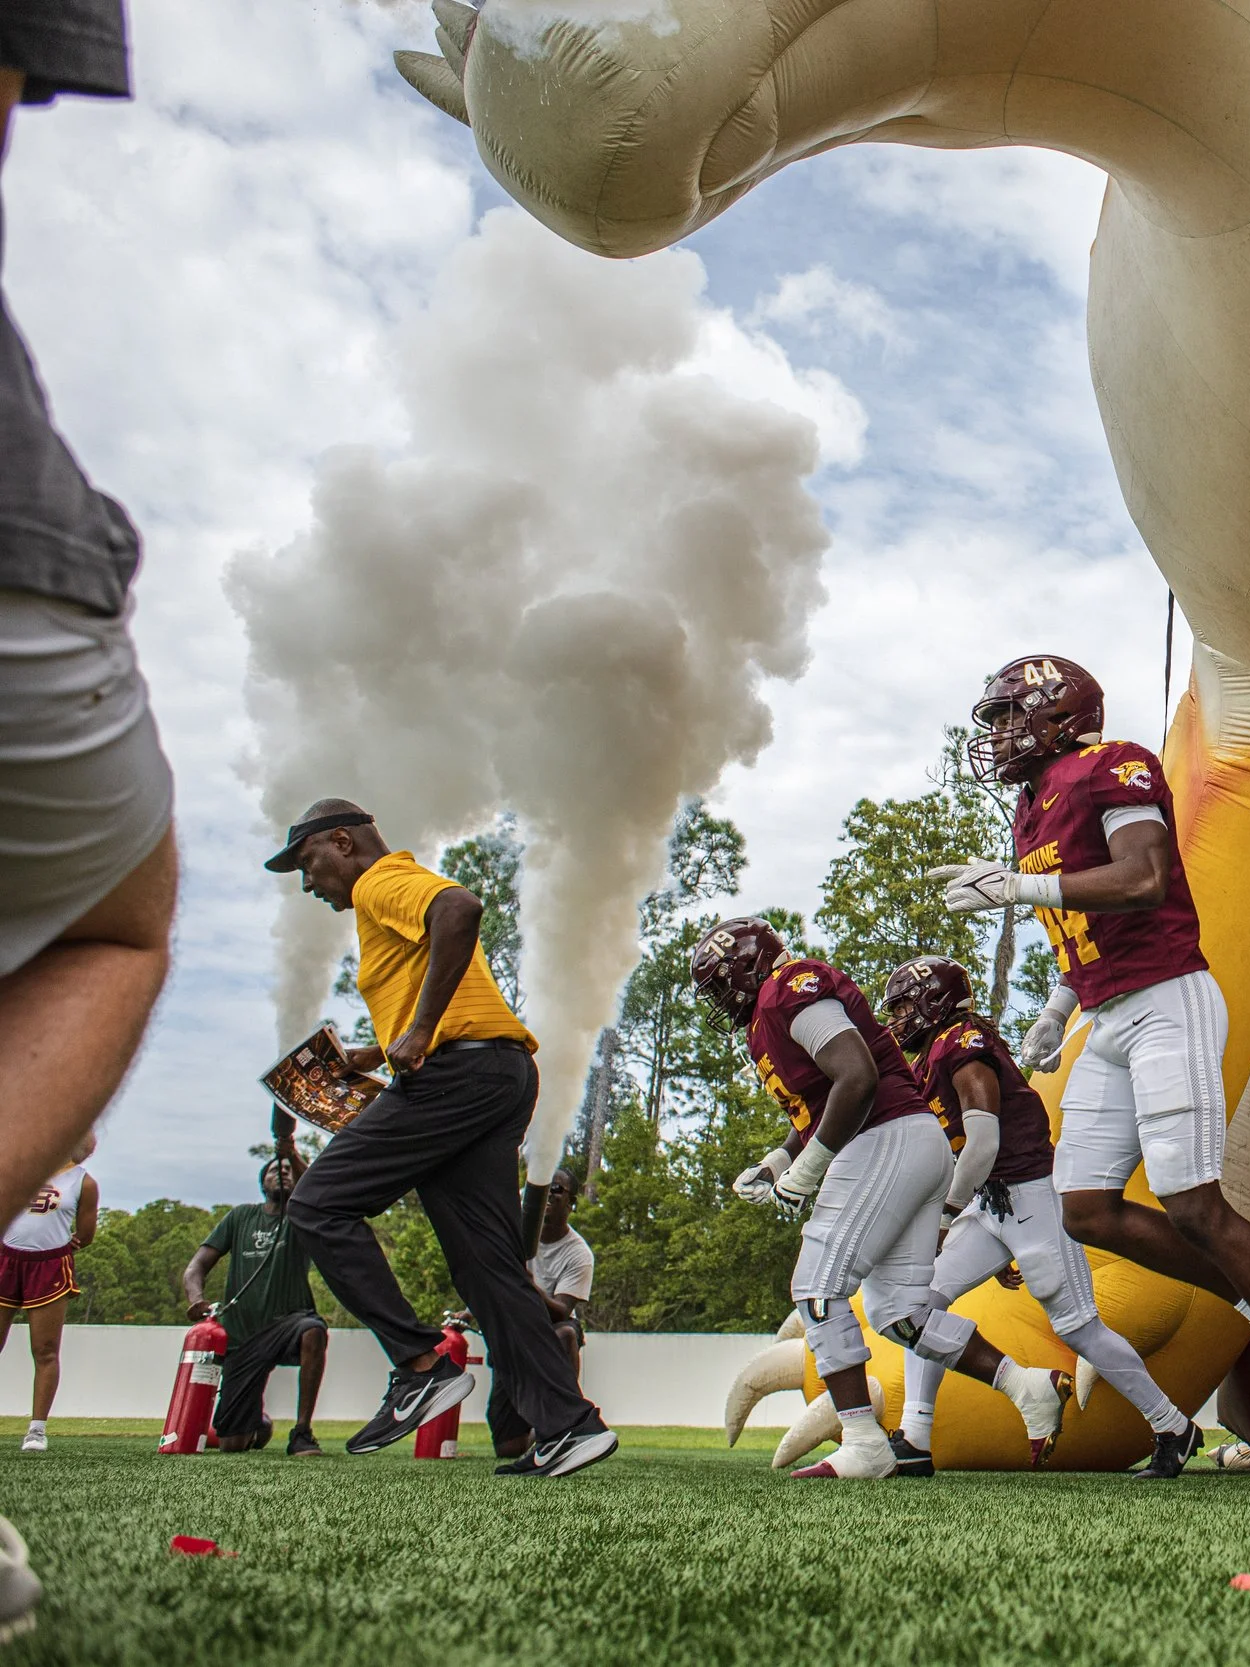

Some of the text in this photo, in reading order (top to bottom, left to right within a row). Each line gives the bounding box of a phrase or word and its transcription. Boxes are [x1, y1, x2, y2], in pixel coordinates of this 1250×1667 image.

[1024, 660, 1063, 687] 44
[704, 930, 736, 959] 79
[908, 961, 933, 982] 15
